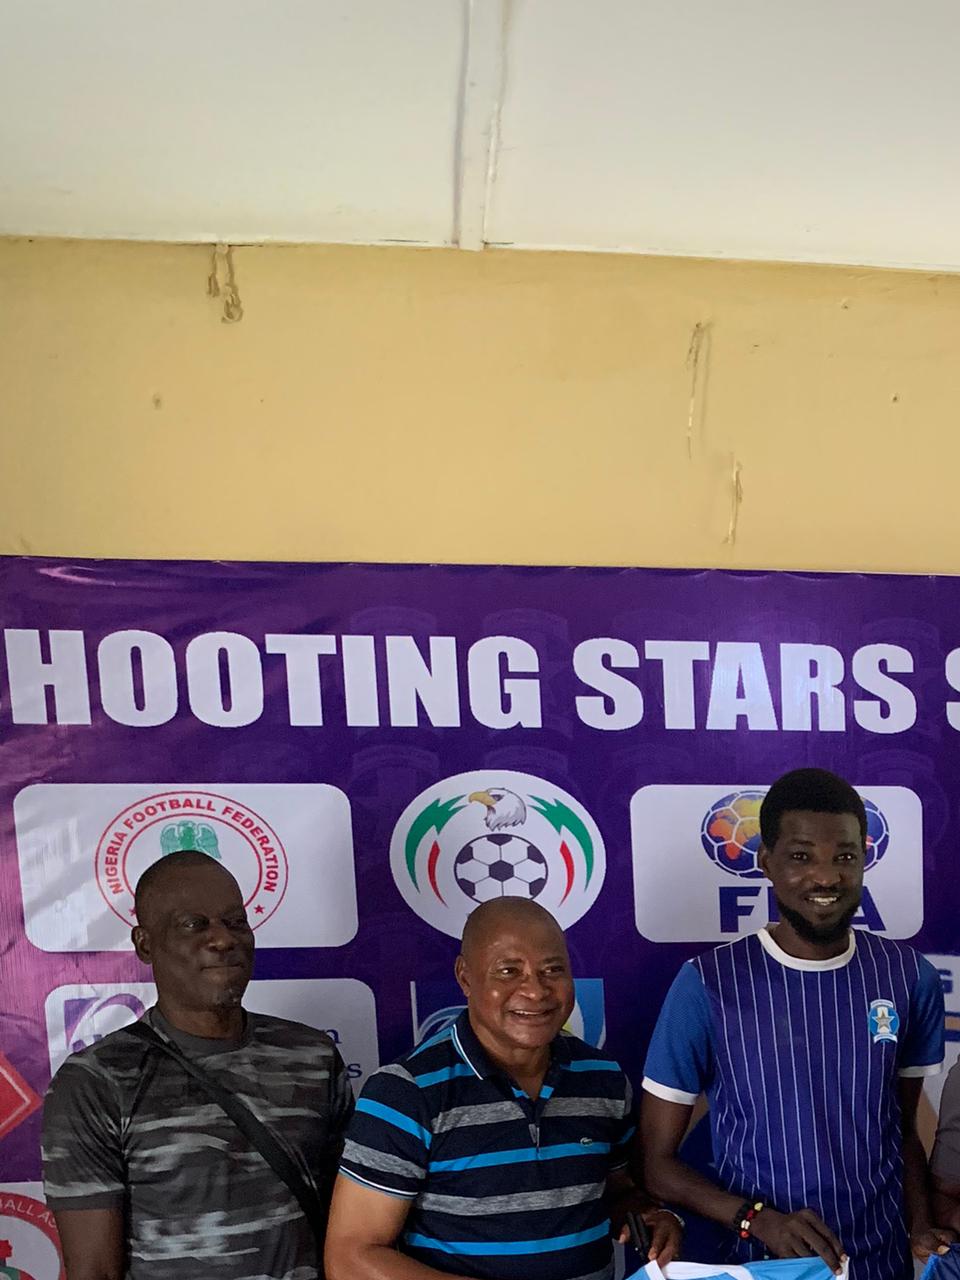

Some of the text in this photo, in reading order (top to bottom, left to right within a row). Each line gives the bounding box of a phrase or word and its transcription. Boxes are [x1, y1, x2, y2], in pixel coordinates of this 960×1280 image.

[4, 628, 543, 729] HOOTING
[573, 637, 917, 735] STARS
[105, 798, 280, 895] NIGERIA FOOTBALL FEDERATION
[719, 886, 887, 933] FIA
